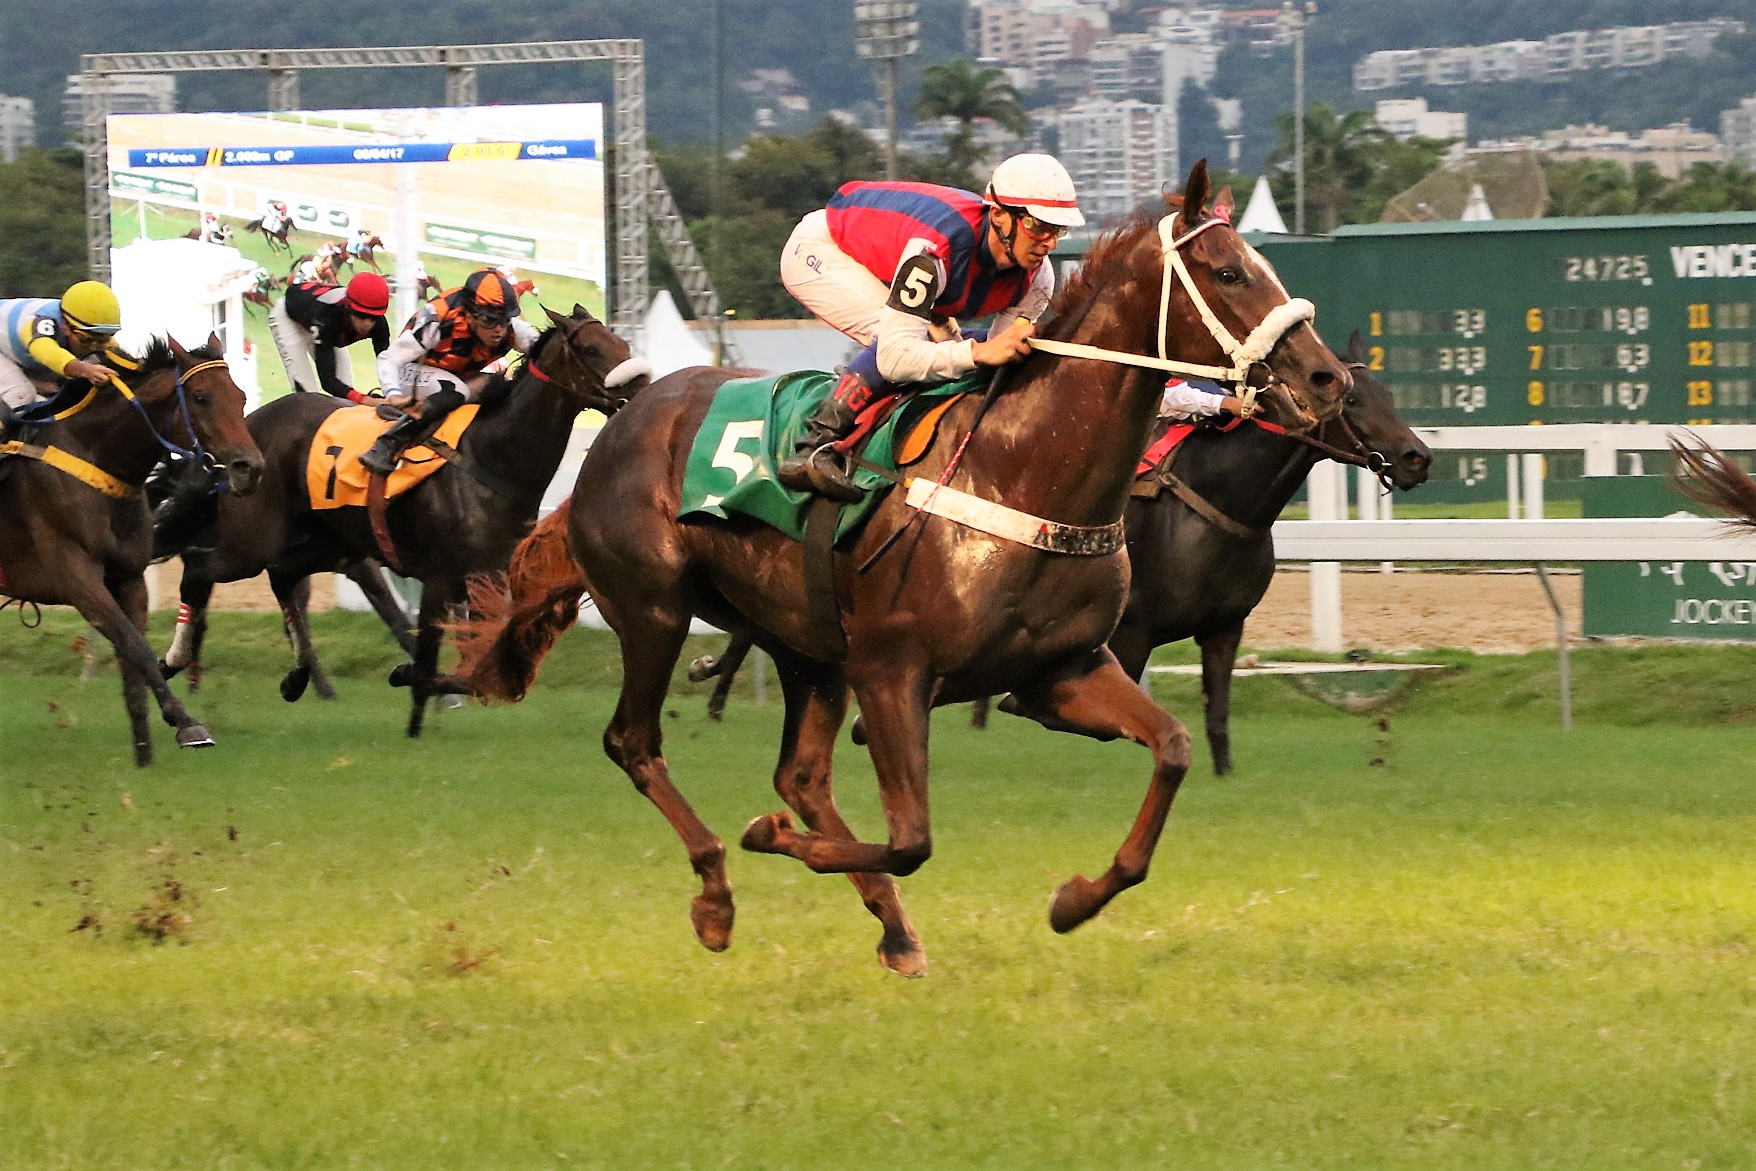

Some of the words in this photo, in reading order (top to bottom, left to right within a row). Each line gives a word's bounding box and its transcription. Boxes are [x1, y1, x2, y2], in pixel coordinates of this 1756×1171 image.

[273, 150, 295, 162] GP
[806, 255, 822, 275] GIL
[1670, 243, 1756, 278] VENCE
[900, 266, 934, 308] 5
[37, 318, 56, 336] 6
[1369, 311, 1383, 337] 1
[1526, 307, 1544, 333] 6
[1687, 304, 1711, 329] 11
[1368, 345, 1385, 371] 2
[1527, 345, 1544, 370] 7
[1687, 340, 1713, 366] 12
[1528, 381, 1544, 406] 8
[1687, 380, 1713, 406] 13
[701, 420, 765, 509] 5
[1669, 599, 1756, 624] JOCKE
